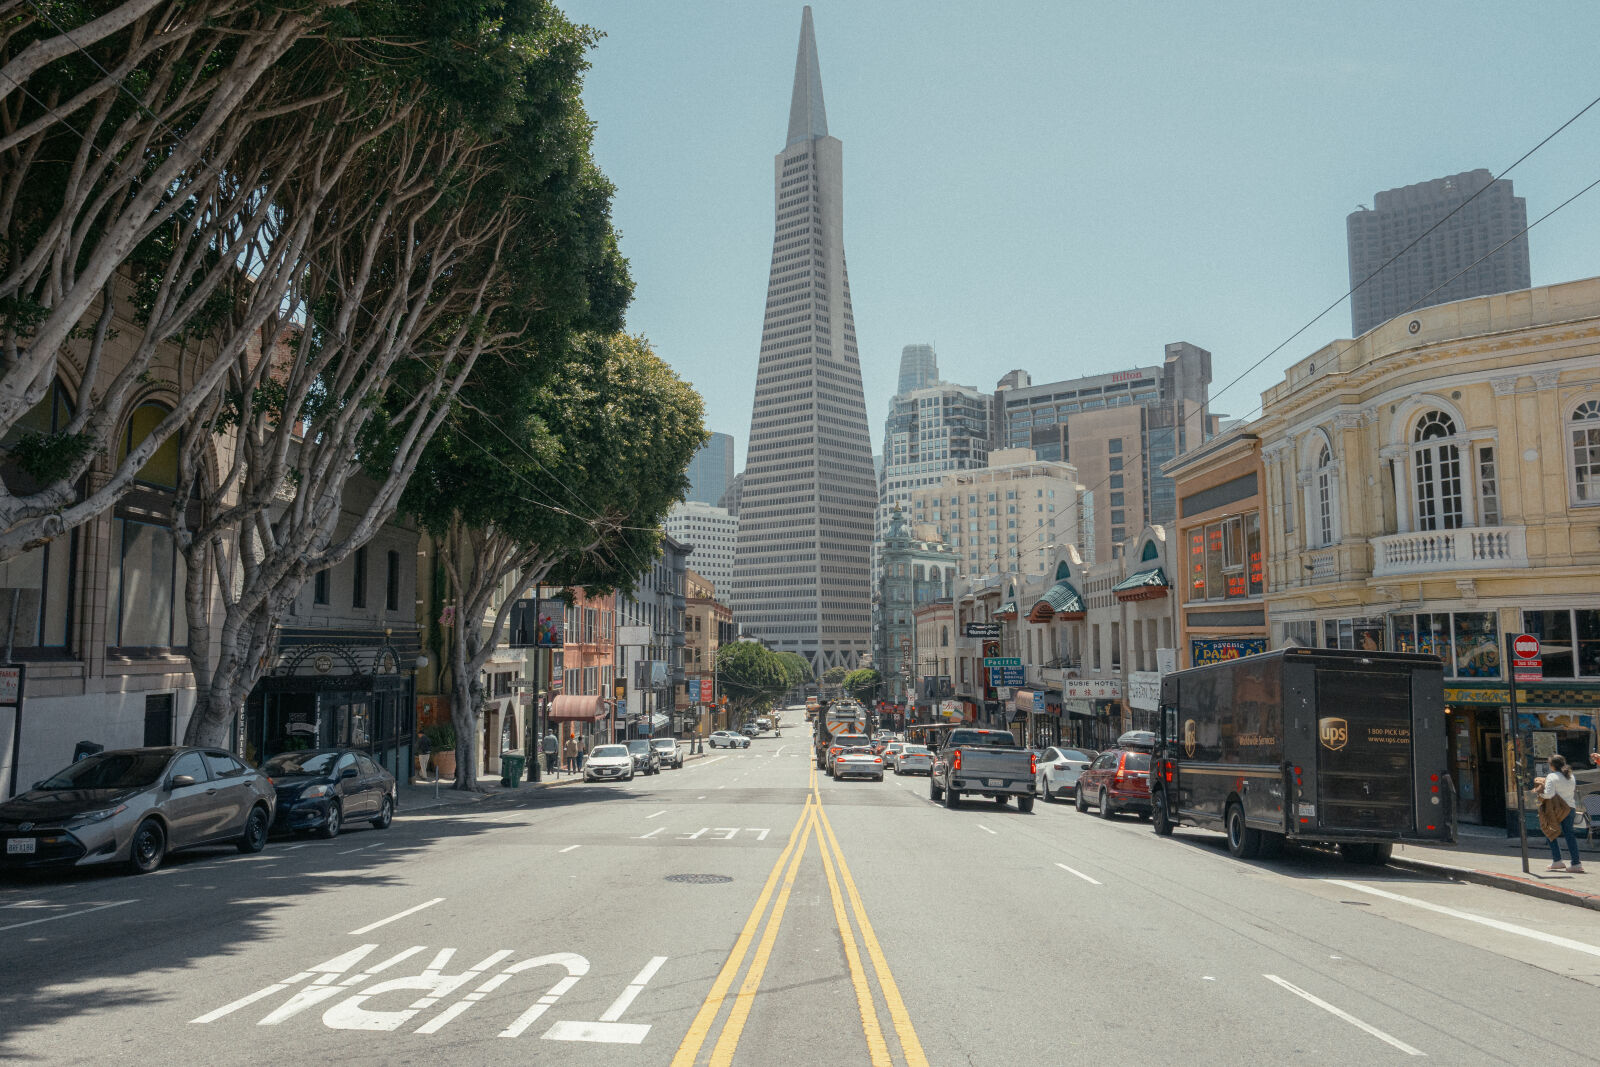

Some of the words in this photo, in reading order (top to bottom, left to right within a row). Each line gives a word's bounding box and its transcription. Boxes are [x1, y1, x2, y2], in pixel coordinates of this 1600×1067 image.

[1112, 371, 1142, 383] Hilton
[1203, 649, 1239, 659] PALM
[1322, 727, 1346, 745] ups
[1368, 736, 1410, 744] www.ups.com
[631, 827, 771, 841] LEFT
[188, 943, 668, 1044] TURN
